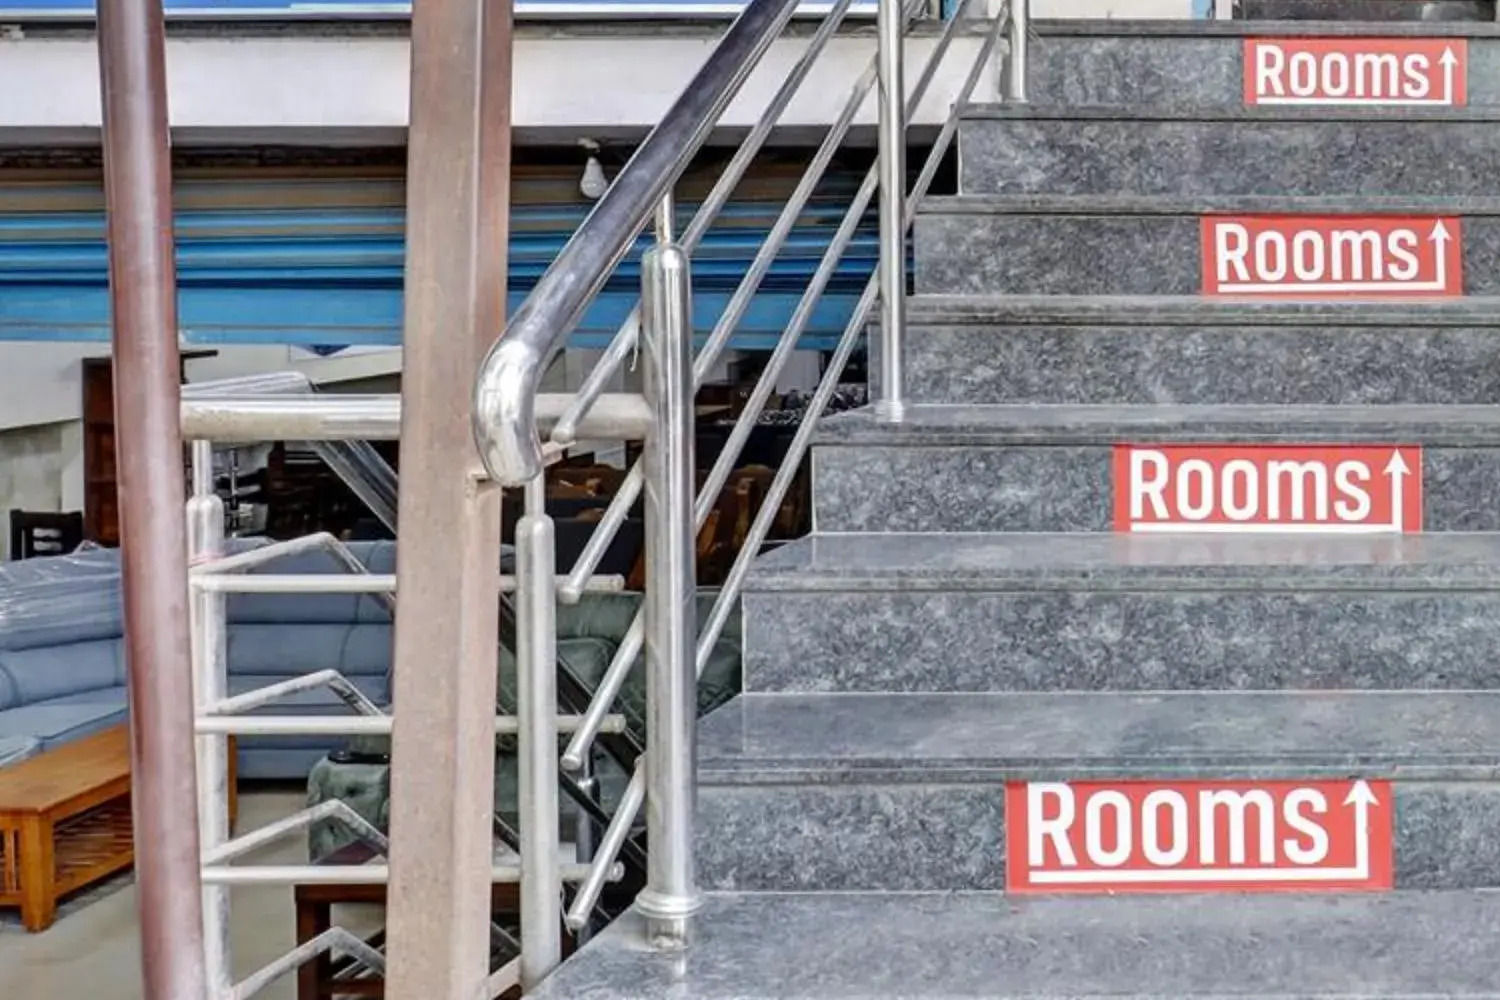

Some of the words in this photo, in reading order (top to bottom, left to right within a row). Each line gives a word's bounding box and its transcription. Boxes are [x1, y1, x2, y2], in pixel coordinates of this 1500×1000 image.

[1255, 44, 1430, 97] Rooms
[1215, 222, 1419, 282] Rooms
[1129, 449, 1371, 521] Rooms
[1027, 781, 1330, 868] Rooms
